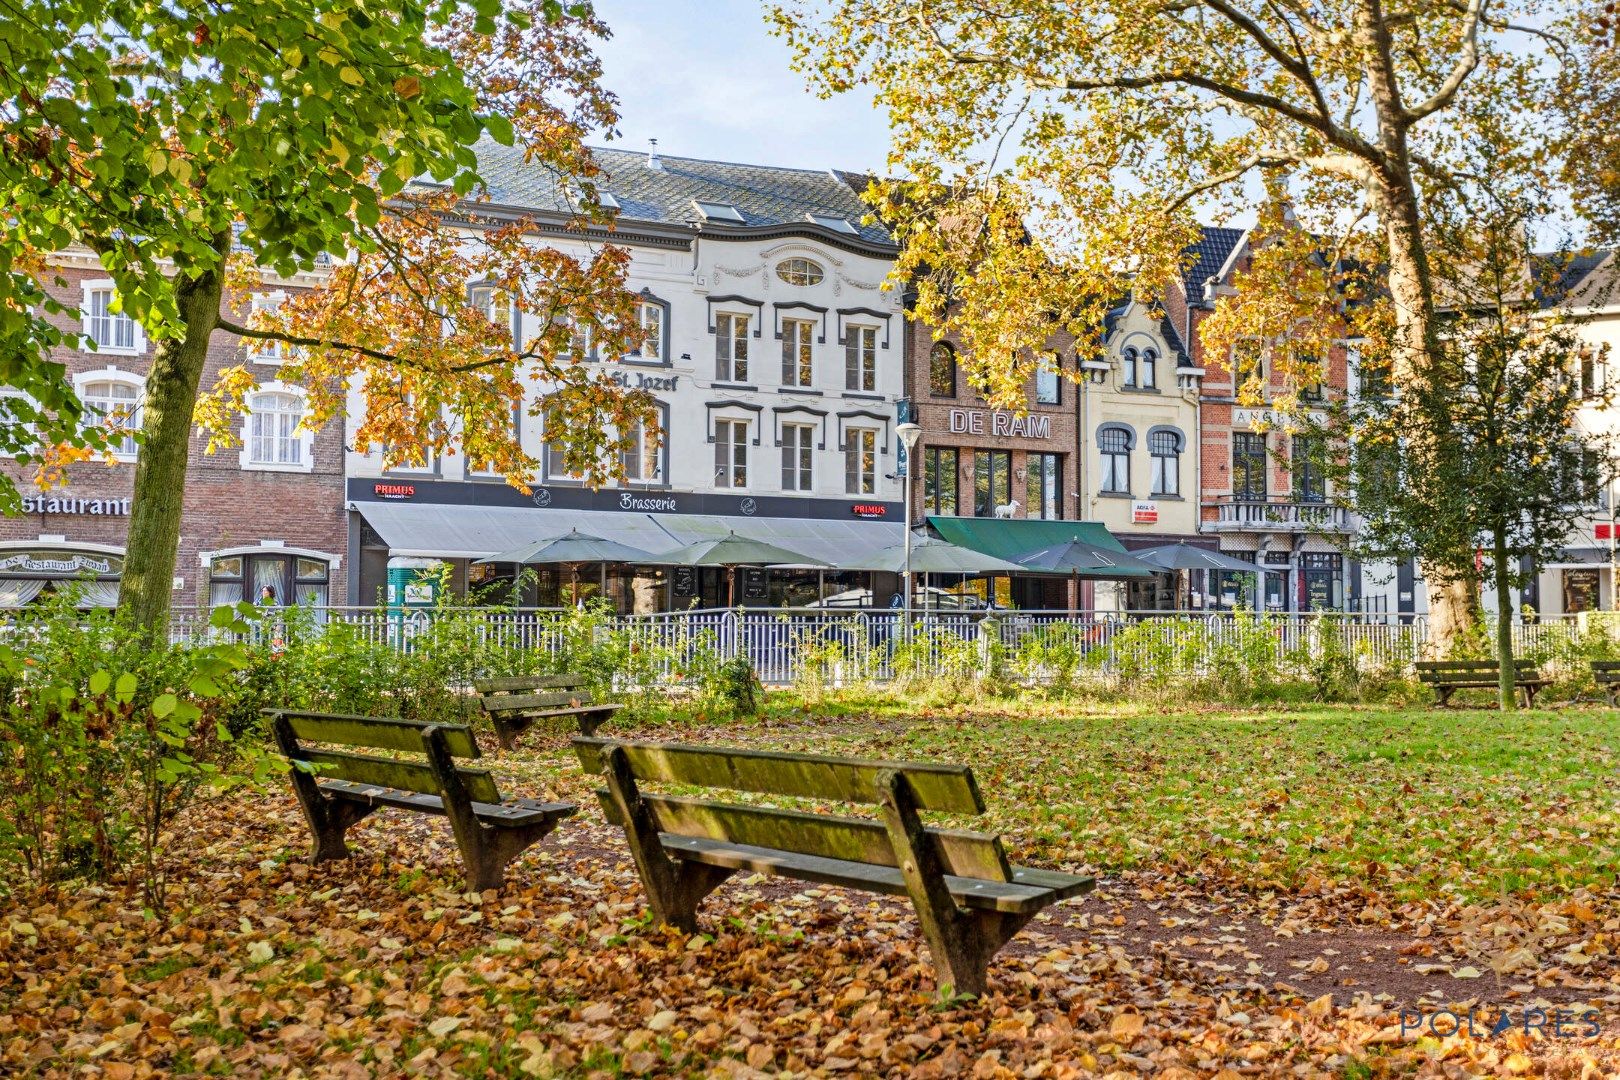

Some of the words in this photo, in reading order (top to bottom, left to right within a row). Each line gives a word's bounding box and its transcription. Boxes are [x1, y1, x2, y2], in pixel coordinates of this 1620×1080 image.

[611, 371, 632, 388] St.
[636, 372, 680, 392] Jozef
[950, 409, 983, 435] DE
[993, 411, 1051, 438] RAM
[375, 484, 415, 495] PRIMUS
[2, 494, 130, 515] staurant
[619, 492, 677, 512] Brasserie
[853, 505, 886, 514] PRIMUS
[24, 559, 76, 570] Restaurant
